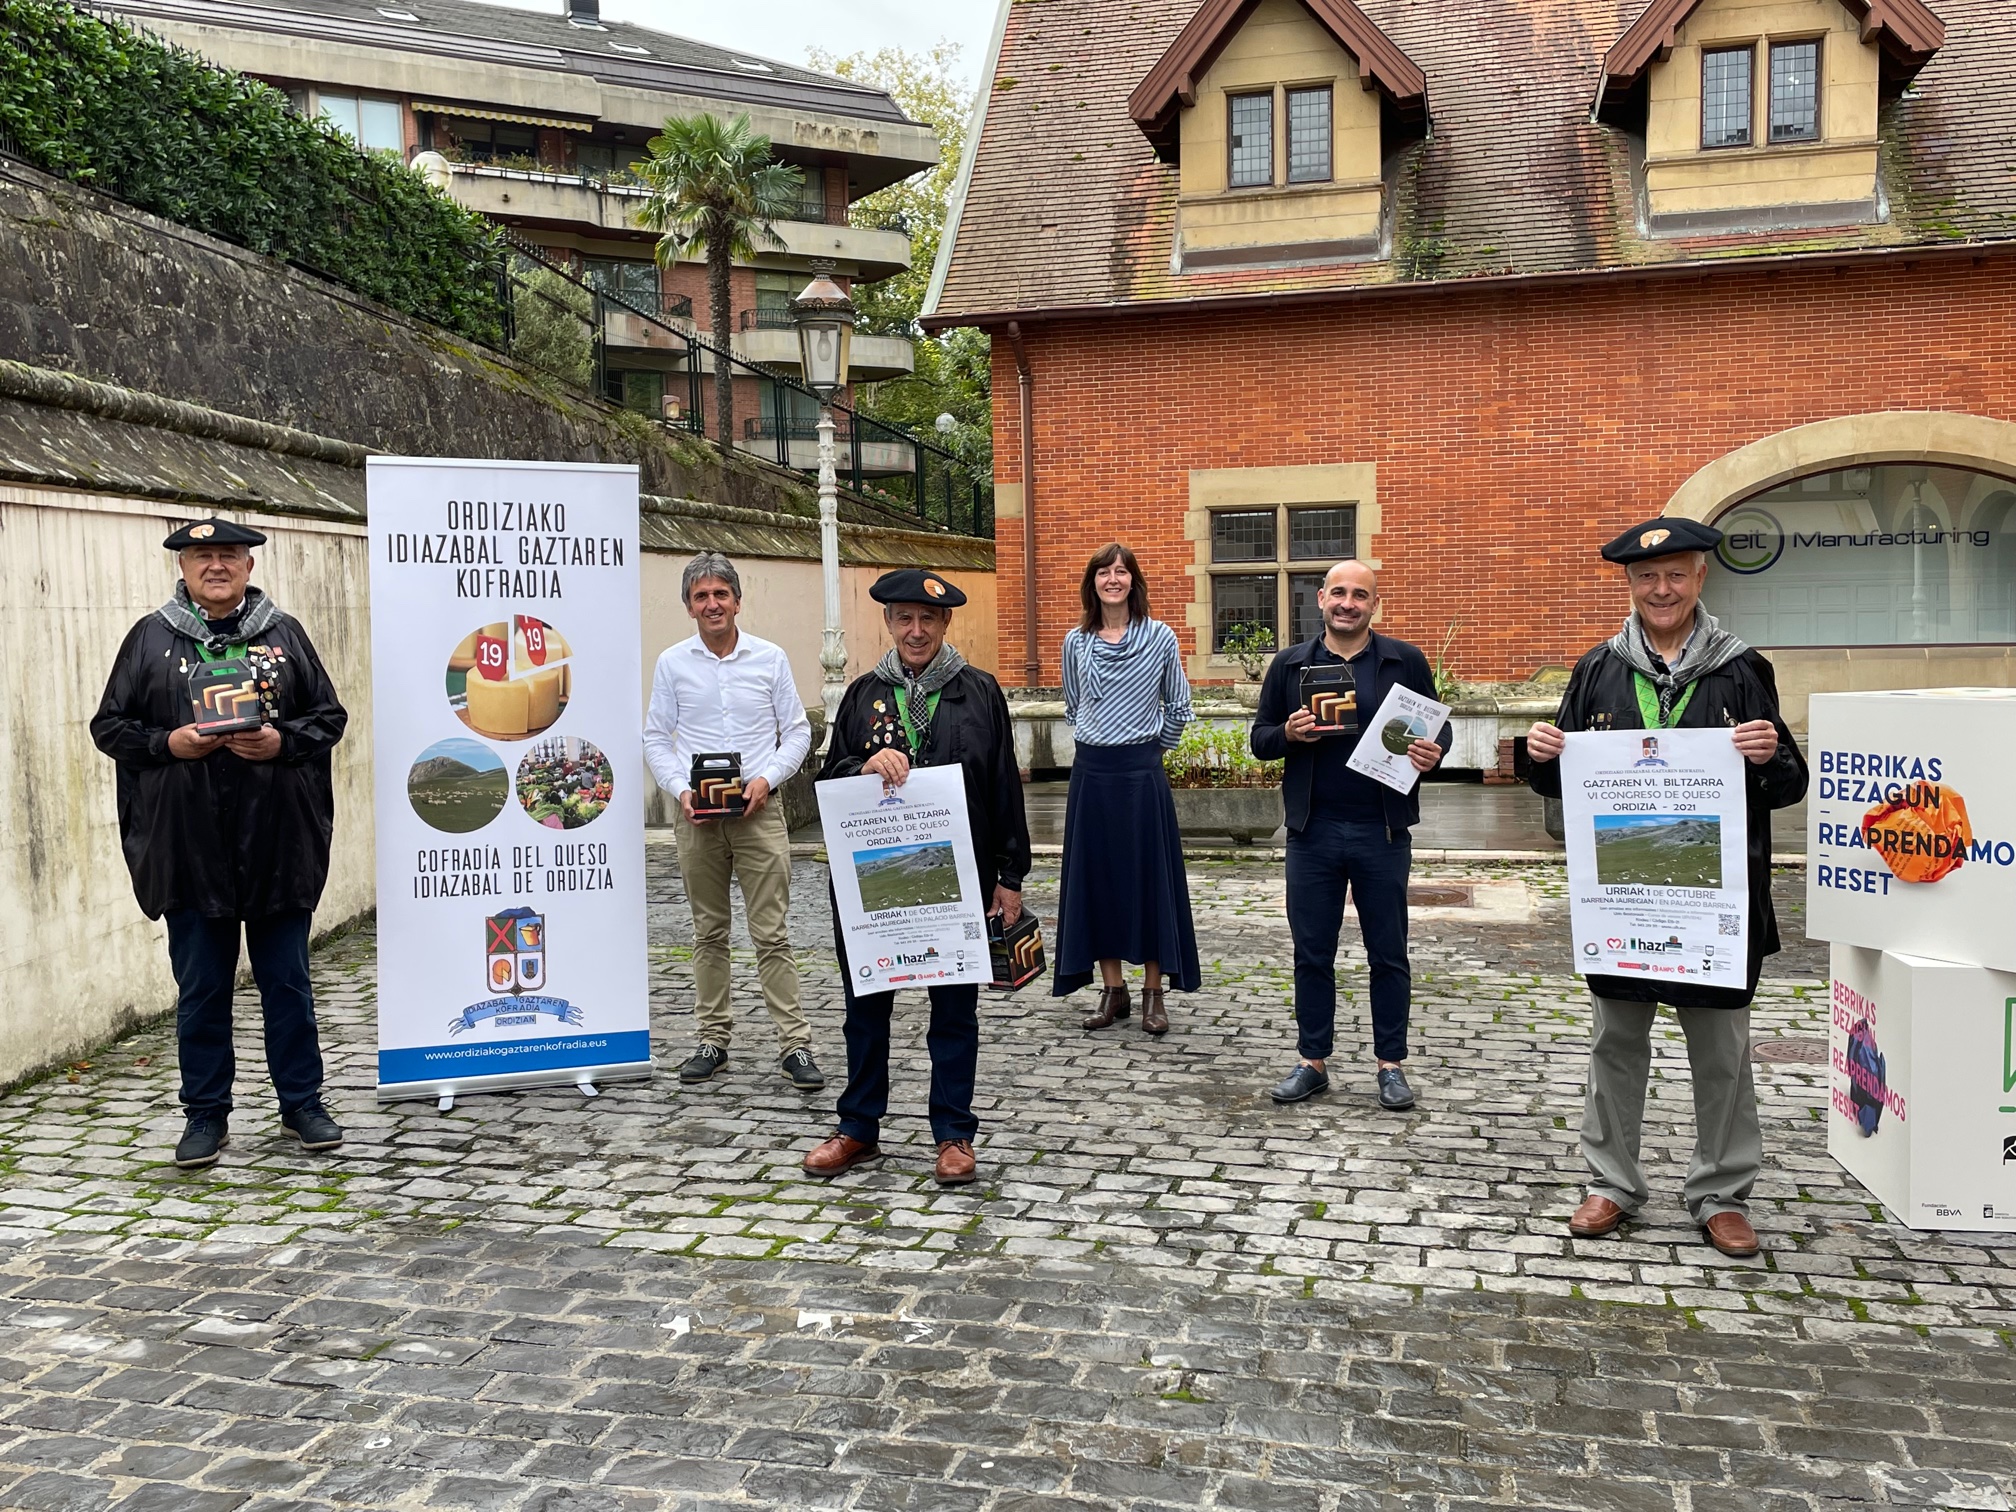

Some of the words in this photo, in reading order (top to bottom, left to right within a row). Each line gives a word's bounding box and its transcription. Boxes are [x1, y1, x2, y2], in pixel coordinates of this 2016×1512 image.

[447, 500, 566, 532] ORDIZIAKO
[388, 533, 503, 564] IDIAZABAL
[518, 536, 624, 566] GAZTAREN
[1729, 529, 1767, 550] eit
[1792, 527, 1990, 548] Manufacturing
[456, 568, 562, 598] KOFRADIA
[526, 627, 542, 651] 19
[480, 641, 503, 667] 19
[1820, 751, 1942, 781] BERRIKAS
[1583, 779, 1642, 788] GAZTAREN
[1644, 779, 1658, 787] VI.
[1663, 778, 1724, 787] BILTZARRA
[1819, 777, 1940, 809] DEZAGUN
[1587, 791, 1598, 800] VI
[1600, 791, 1661, 800] CONGRESO
[1664, 790, 1679, 799] DE
[1682, 790, 1721, 800] QUESO
[1612, 803, 1657, 811] ORDIZIA
[840, 816, 887, 829] GAZTAREN
[888, 815, 900, 823] VI.
[903, 808, 951, 821] BILTZARRA
[845, 830, 854, 839] VI
[856, 825, 903, 838] CONGRESO
[906, 823, 918, 832] DE
[919, 819, 950, 830] QUESO
[866, 836, 902, 847] ORDIZIA
[914, 833, 932, 841] 2021
[1818, 822, 2015, 866] REAPRENDAMO
[418, 844, 501, 873] COFRADÍA
[513, 846, 544, 868] DEL
[555, 843, 607, 867] QUESO
[414, 873, 502, 899] IDIAZABAL
[513, 871, 534, 894] DE
[546, 868, 614, 893] ORDIZIA
[1818, 864, 1894, 895] RESET
[1581, 897, 1615, 905] BARRENA
[1702, 901, 1737, 909] BARRENA
[1605, 887, 1645, 896] URRIAK
[1645, 888, 1650, 896] 1
[1666, 889, 1716, 899] OCTUBRE
[870, 910, 902, 921] URRIAK
[919, 904, 959, 915] OCTUBRE
[851, 923, 879, 932] BARRENA
[1638, 938, 1665, 952] hazi
[903, 953, 926, 965] hazi
[465, 998, 509, 1015] IDIAZABAL
[519, 996, 566, 1008] GAZTAREN
[495, 1004, 540, 1014] KOFRADIA
[1833, 979, 1876, 1025] BERRIKAS
[496, 1015, 535, 1026] ORDIZIAN
[424, 1038, 607, 1061] www.ordiziakogaztarenkofradia.eus
[1832, 1047, 1906, 1122] REAPRENDAMOS
[1832, 1086, 1860, 1125] RESET
[1936, 1208, 1962, 1216] BBVA
